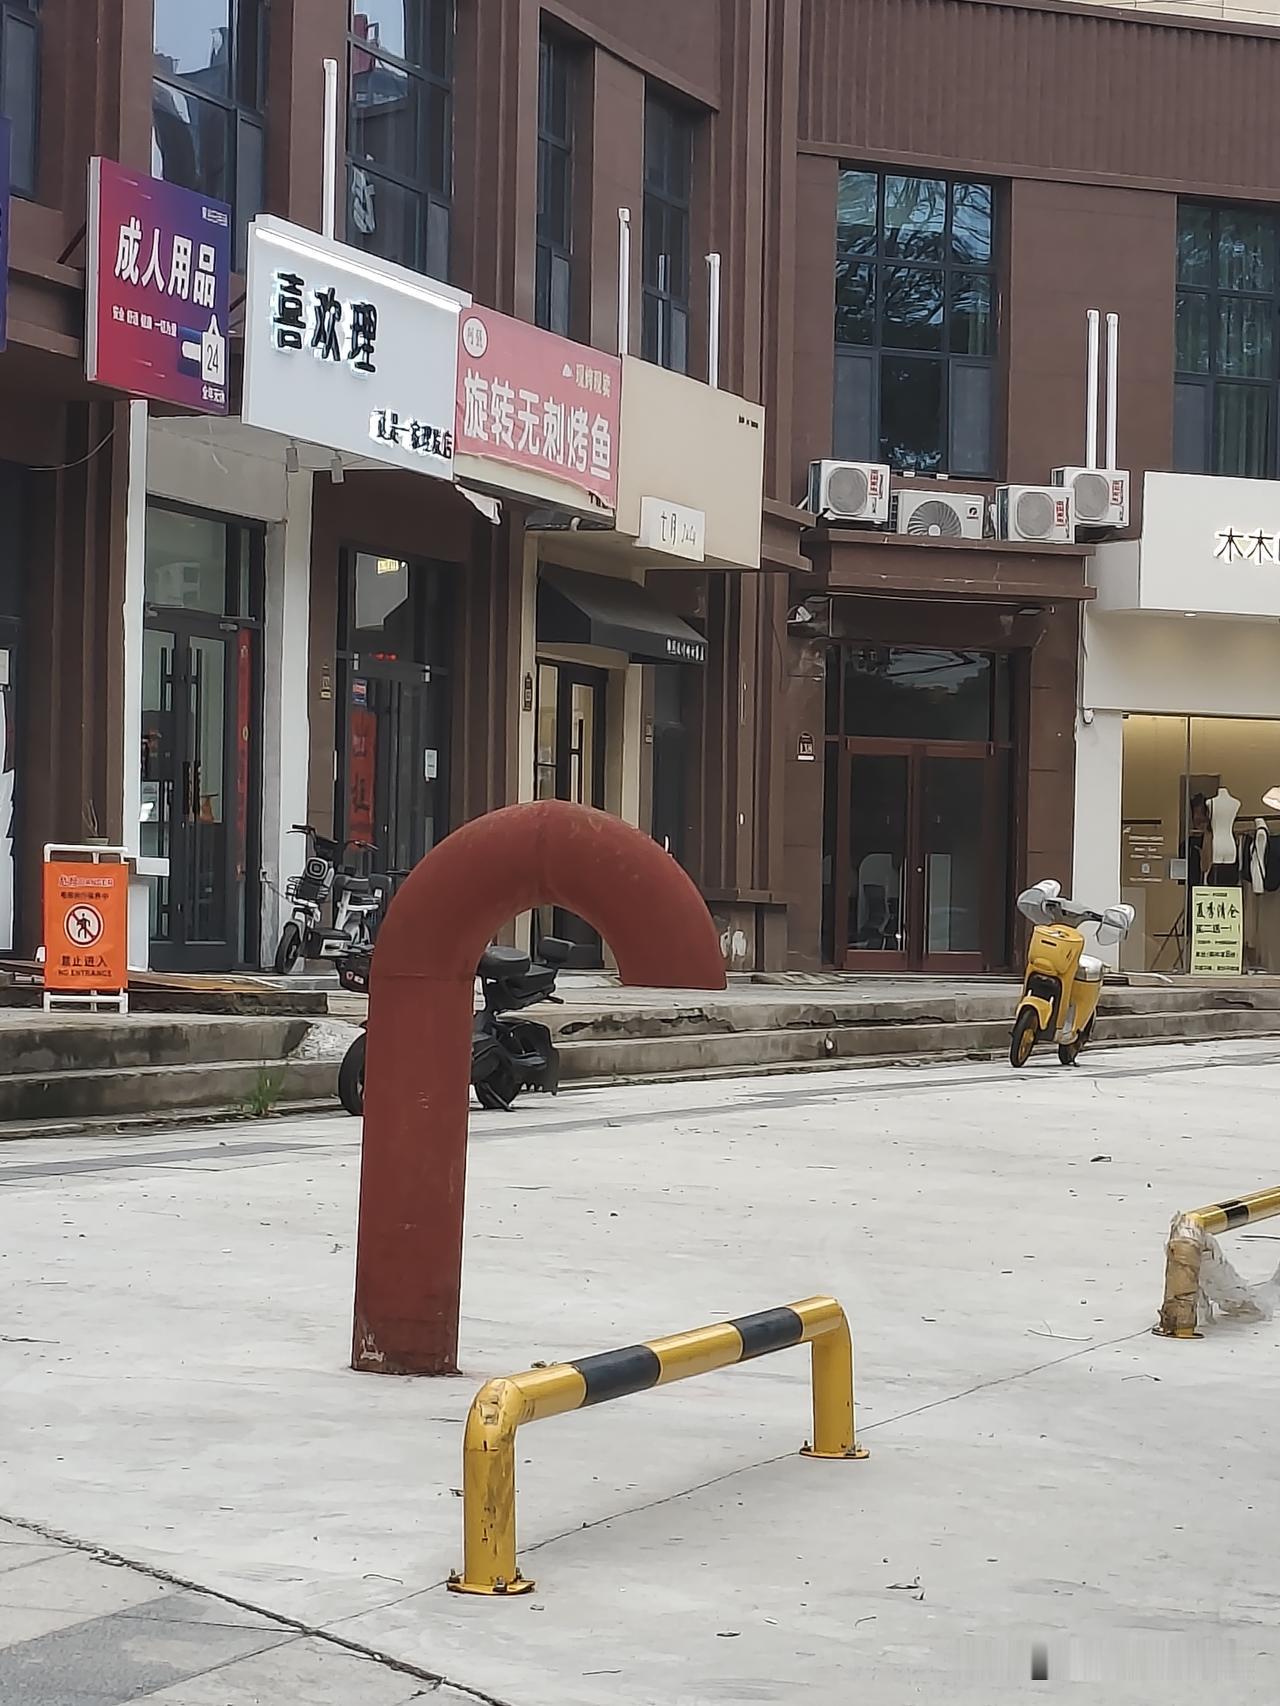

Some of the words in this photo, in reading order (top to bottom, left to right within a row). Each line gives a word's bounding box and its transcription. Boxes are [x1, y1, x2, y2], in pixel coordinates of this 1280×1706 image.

[114, 215, 216, 308] 成人用品
[206, 343, 219, 373] 24
[273, 271, 377, 373] 喜欢理
[464, 367, 611, 481] 旋转无刺烤鱼
[1216, 527, 1280, 563] 木木
